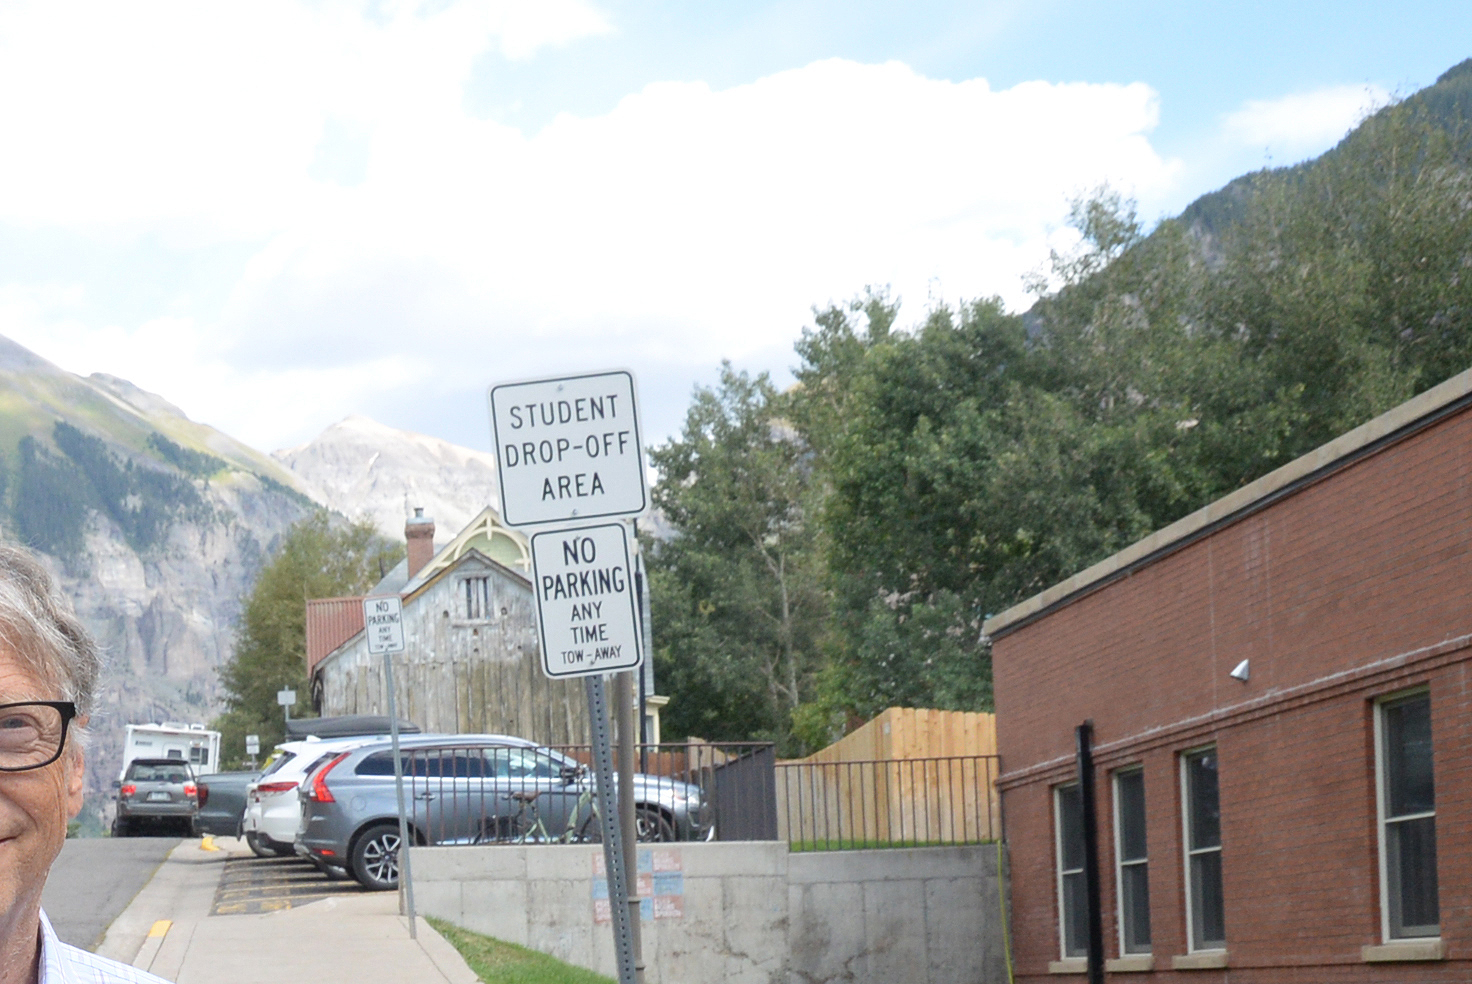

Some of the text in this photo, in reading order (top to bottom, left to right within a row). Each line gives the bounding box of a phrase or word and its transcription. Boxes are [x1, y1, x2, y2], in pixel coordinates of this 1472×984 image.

[510, 395, 618, 429] STUDENT
[505, 431, 630, 467] DROP-OFF
[541, 473, 605, 501] AREA
[563, 537, 596, 566] NO
[543, 566, 625, 601] PARKING
[368, 613, 400, 626] PARKING
[376, 602, 389, 612] NO
[571, 601, 602, 622] ANY
[570, 623, 609, 645] TIME
